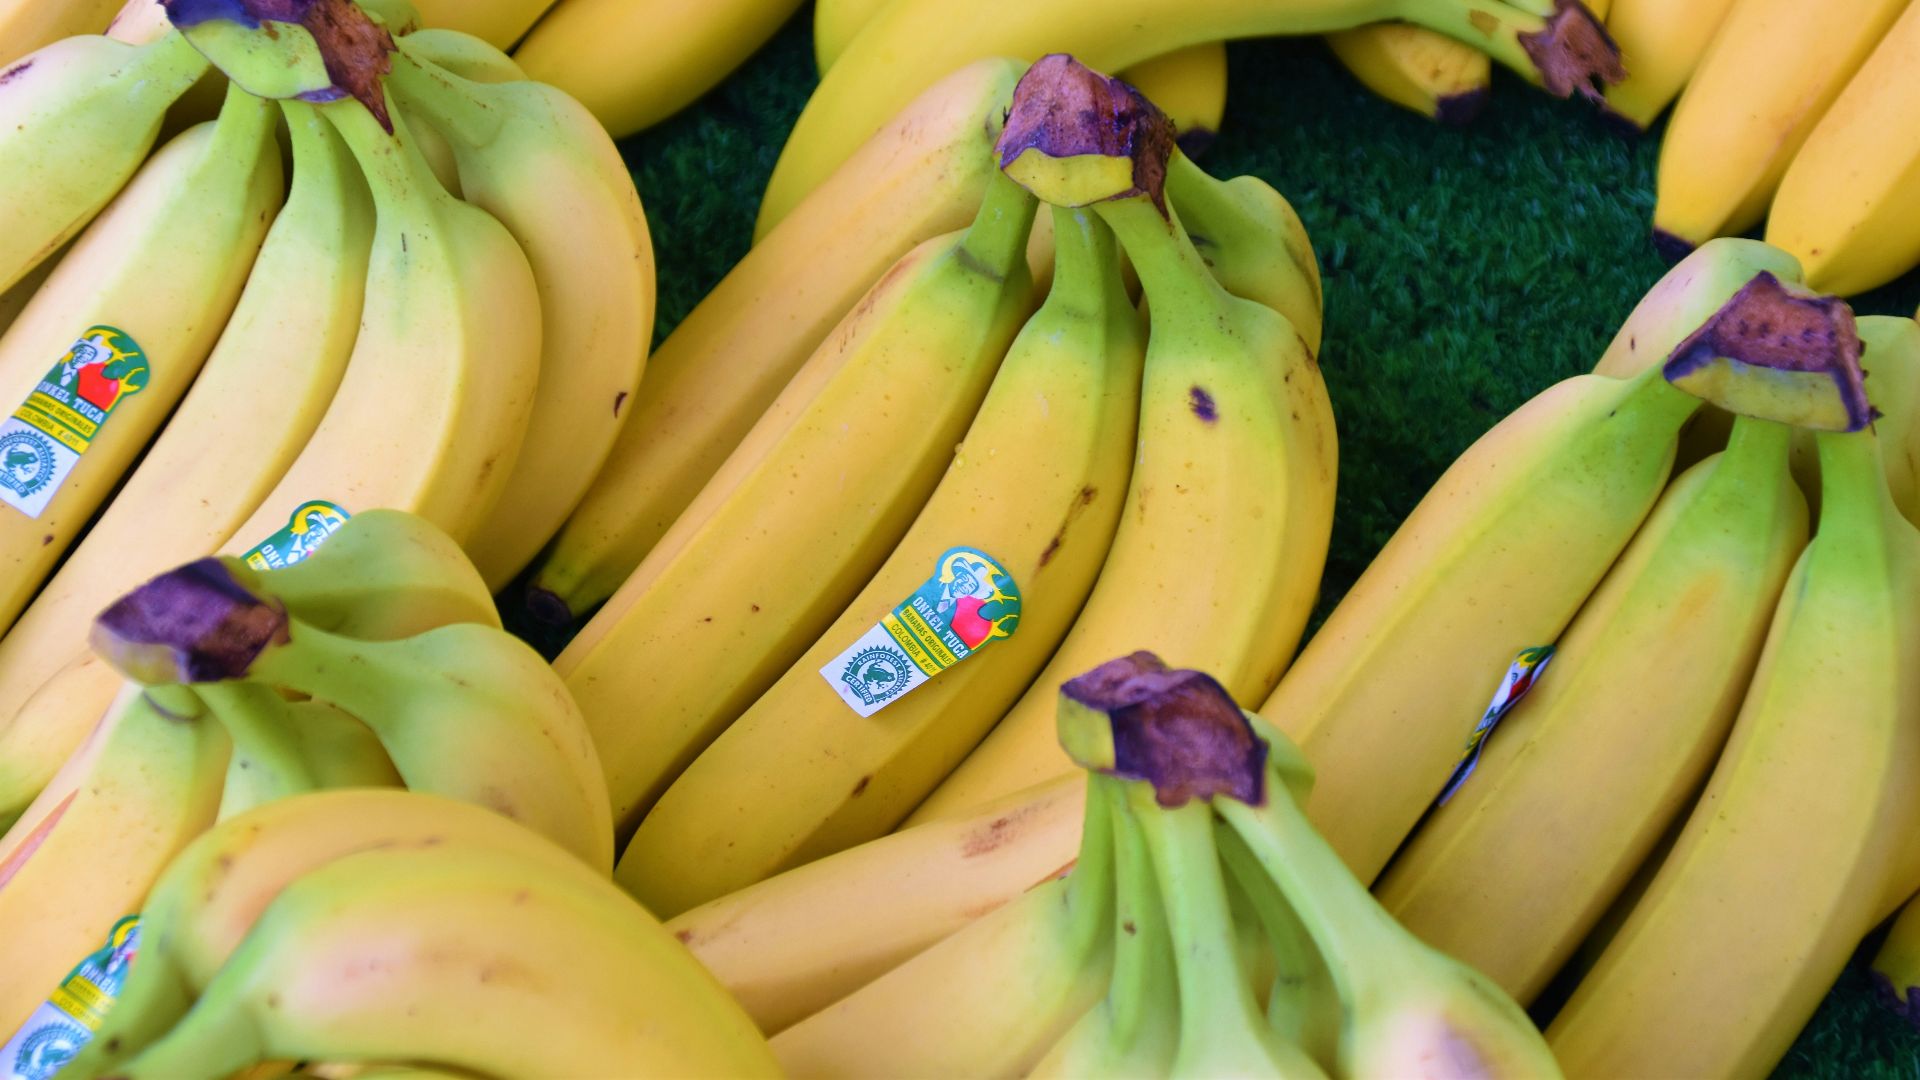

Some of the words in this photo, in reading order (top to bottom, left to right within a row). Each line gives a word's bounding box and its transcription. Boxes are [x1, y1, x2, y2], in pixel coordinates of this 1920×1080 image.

[72, 397, 105, 424] TUCA
[262, 543, 286, 569] ONK
[891, 623, 921, 657] COLOMBIA
[903, 608, 928, 637] BANANAS
[924, 635, 954, 665] ORIGINALES
[912, 596, 944, 633] ONKEL
[943, 629, 969, 659] TUCA
[857, 652, 900, 668] RAINFOREST
[845, 675, 873, 703] CERTIFIED
